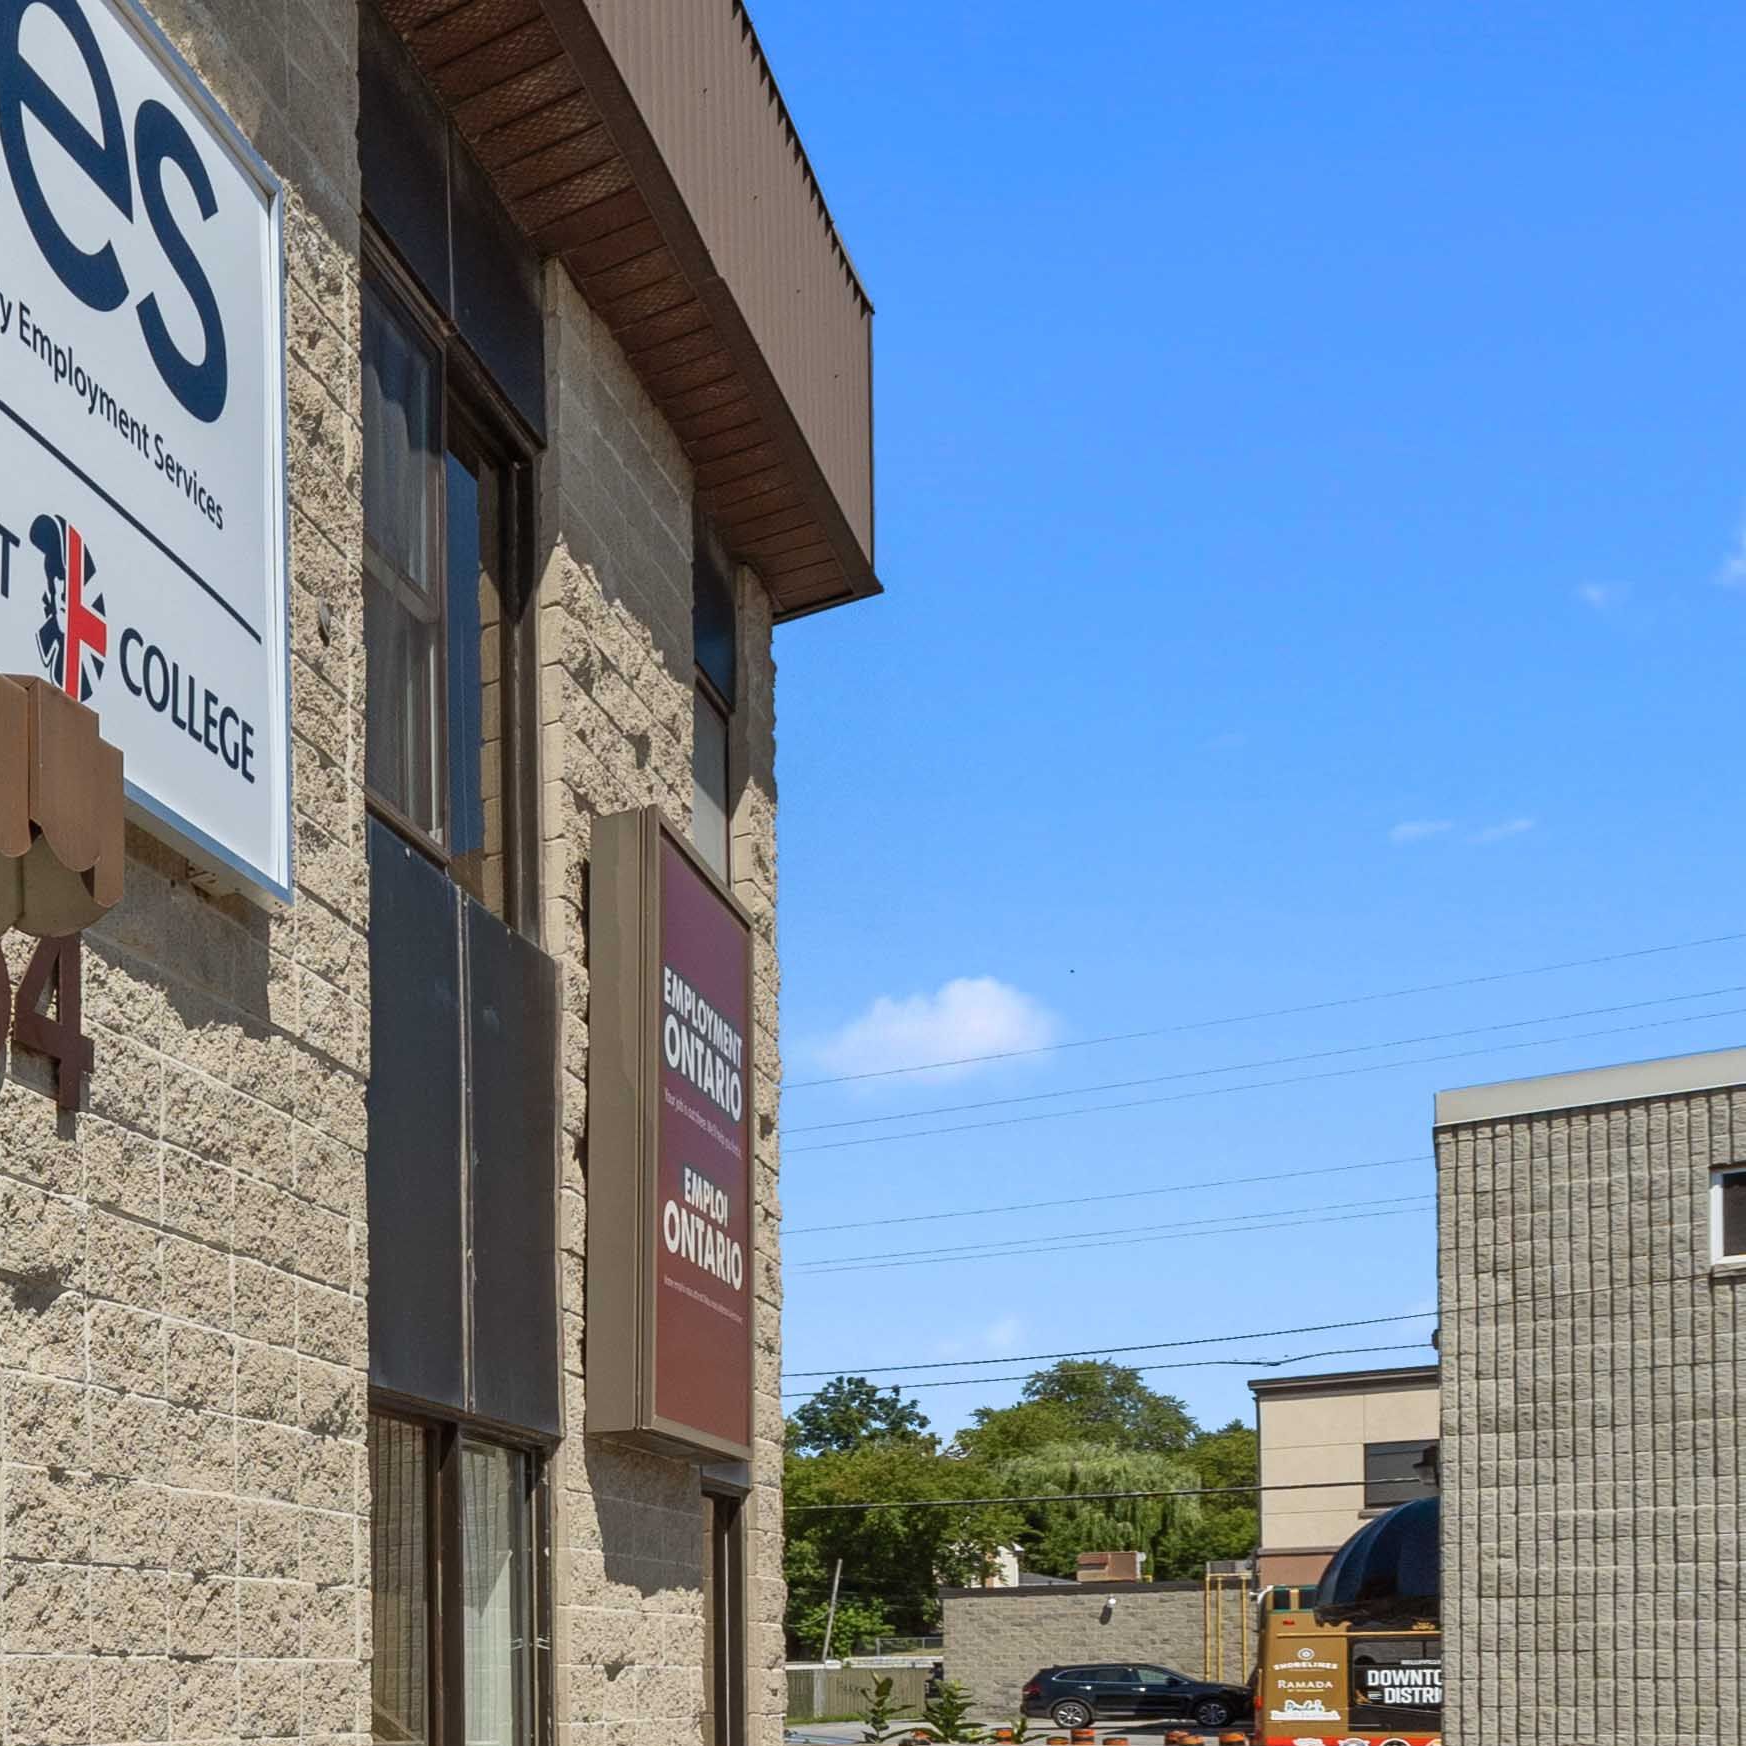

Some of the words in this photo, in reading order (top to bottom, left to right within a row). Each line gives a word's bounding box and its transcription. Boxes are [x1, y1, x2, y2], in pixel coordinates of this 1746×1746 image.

[18, 300, 150, 460] Employment
[154, 433, 224, 531] Services
[118, 627, 256, 785] COLLEGE
[663, 966, 743, 1070] EMPLOYMENT
[663, 1013, 743, 1123] ONTARIO
[663, 1199, 743, 1291] ONTARIO
[683, 1167, 729, 1229] EMPLOI
[1277, 1679, 1334, 1690] RAMADA
[1384, 1687, 1442, 1704] DISTRI
